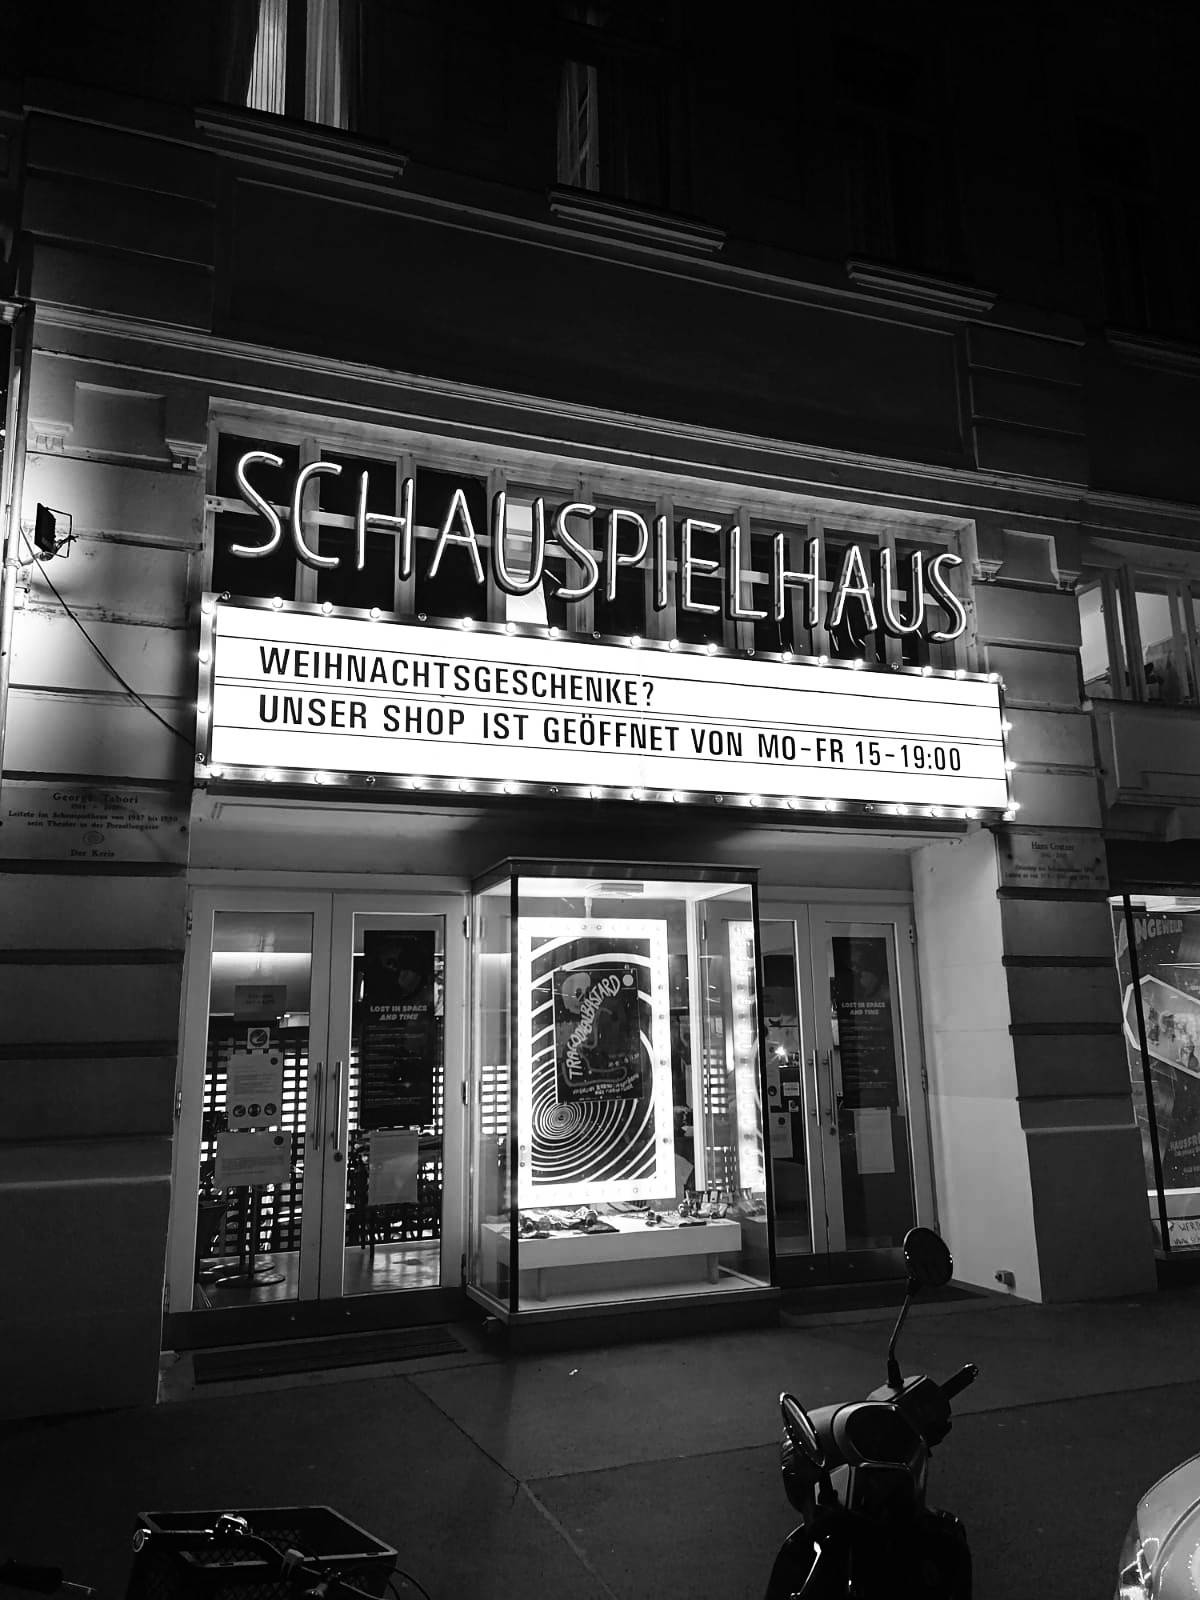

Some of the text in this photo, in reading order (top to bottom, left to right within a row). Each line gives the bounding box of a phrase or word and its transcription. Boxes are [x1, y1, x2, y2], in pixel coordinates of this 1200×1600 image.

[230, 450, 969, 643] SCHAUSPIELHAUS
[259, 645, 655, 707] WEIHNACHTSGESCHENKE?
[259, 694, 367, 729] UNSER
[383, 704, 466, 736] SHOP
[482, 712, 530, 741] IST
[543, 713, 680, 752] GEÖFFNET
[690, 727, 743, 757] VON
[855, 740, 962, 771] 15-19:00
[370, 1005, 390, 1013] LOST
[402, 1004, 428, 1012] SPACE
[379, 1013, 398, 1021] AND
